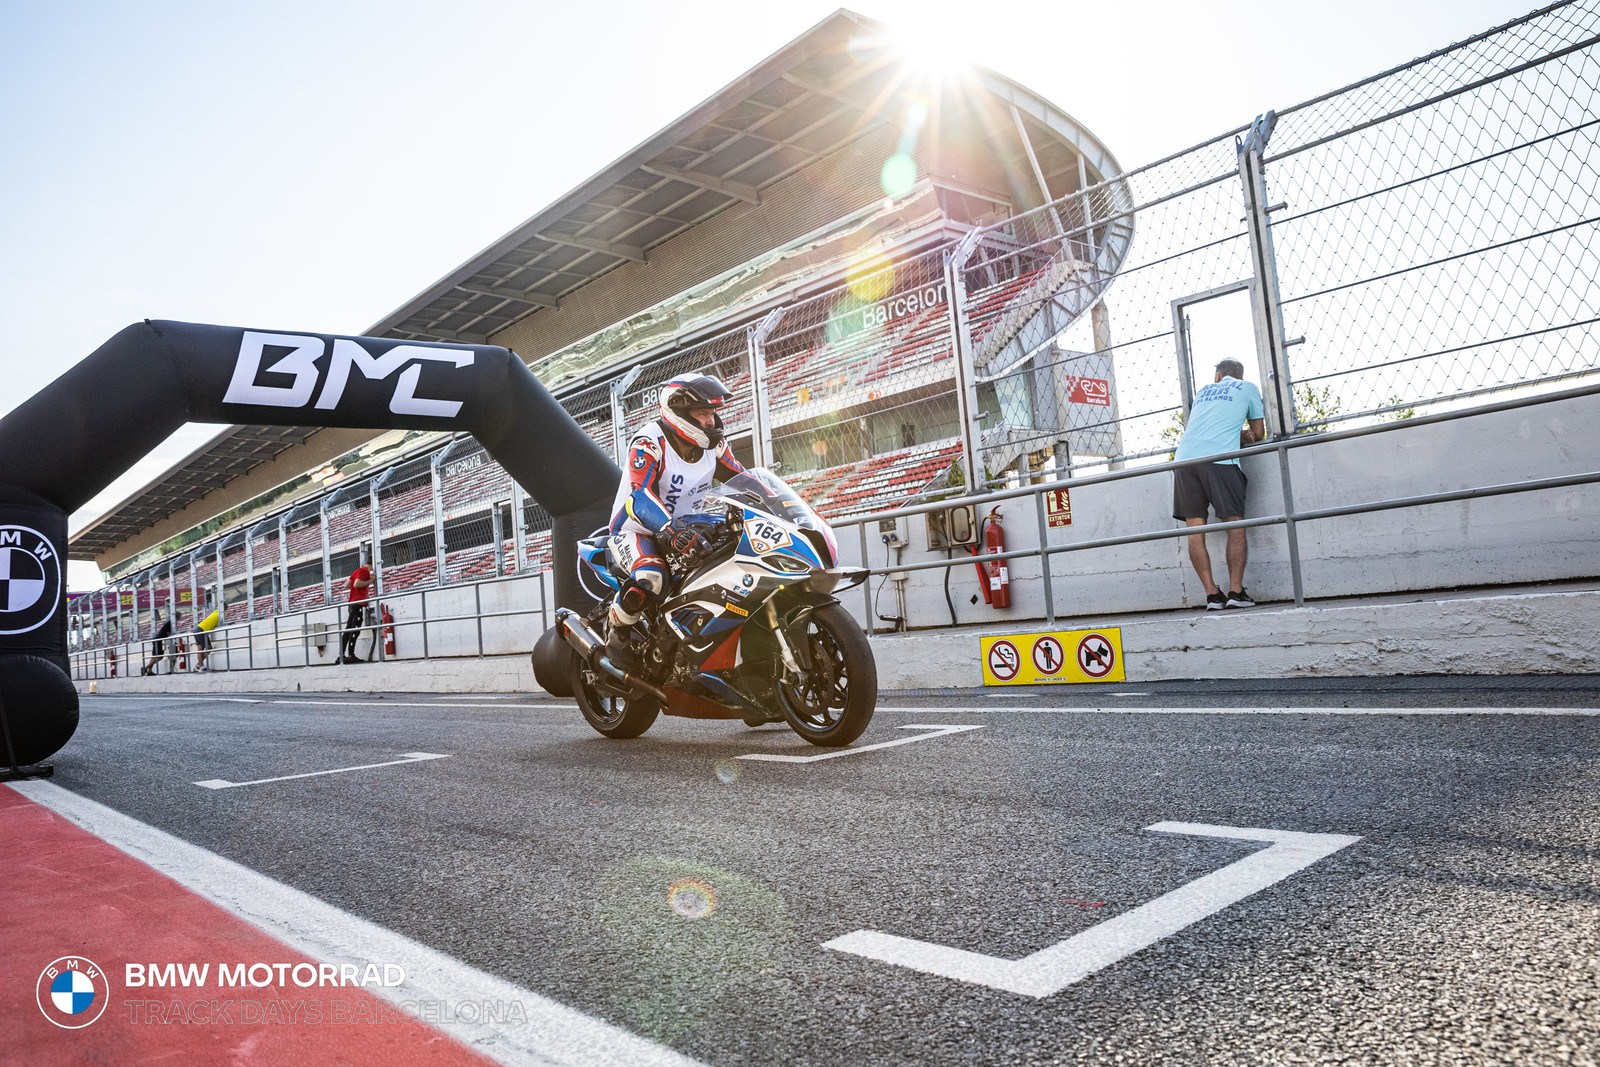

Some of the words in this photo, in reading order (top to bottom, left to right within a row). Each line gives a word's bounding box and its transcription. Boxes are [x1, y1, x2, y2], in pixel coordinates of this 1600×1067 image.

[862, 283, 948, 330] Barcelon
[222, 331, 474, 417] BMC
[665, 474, 684, 517] DAYS
[1050, 513, 1071, 522] EXTINTOR
[0, 531, 53, 561] MW
[755, 522, 783, 545] 164
[756, 542, 764, 551] 12
